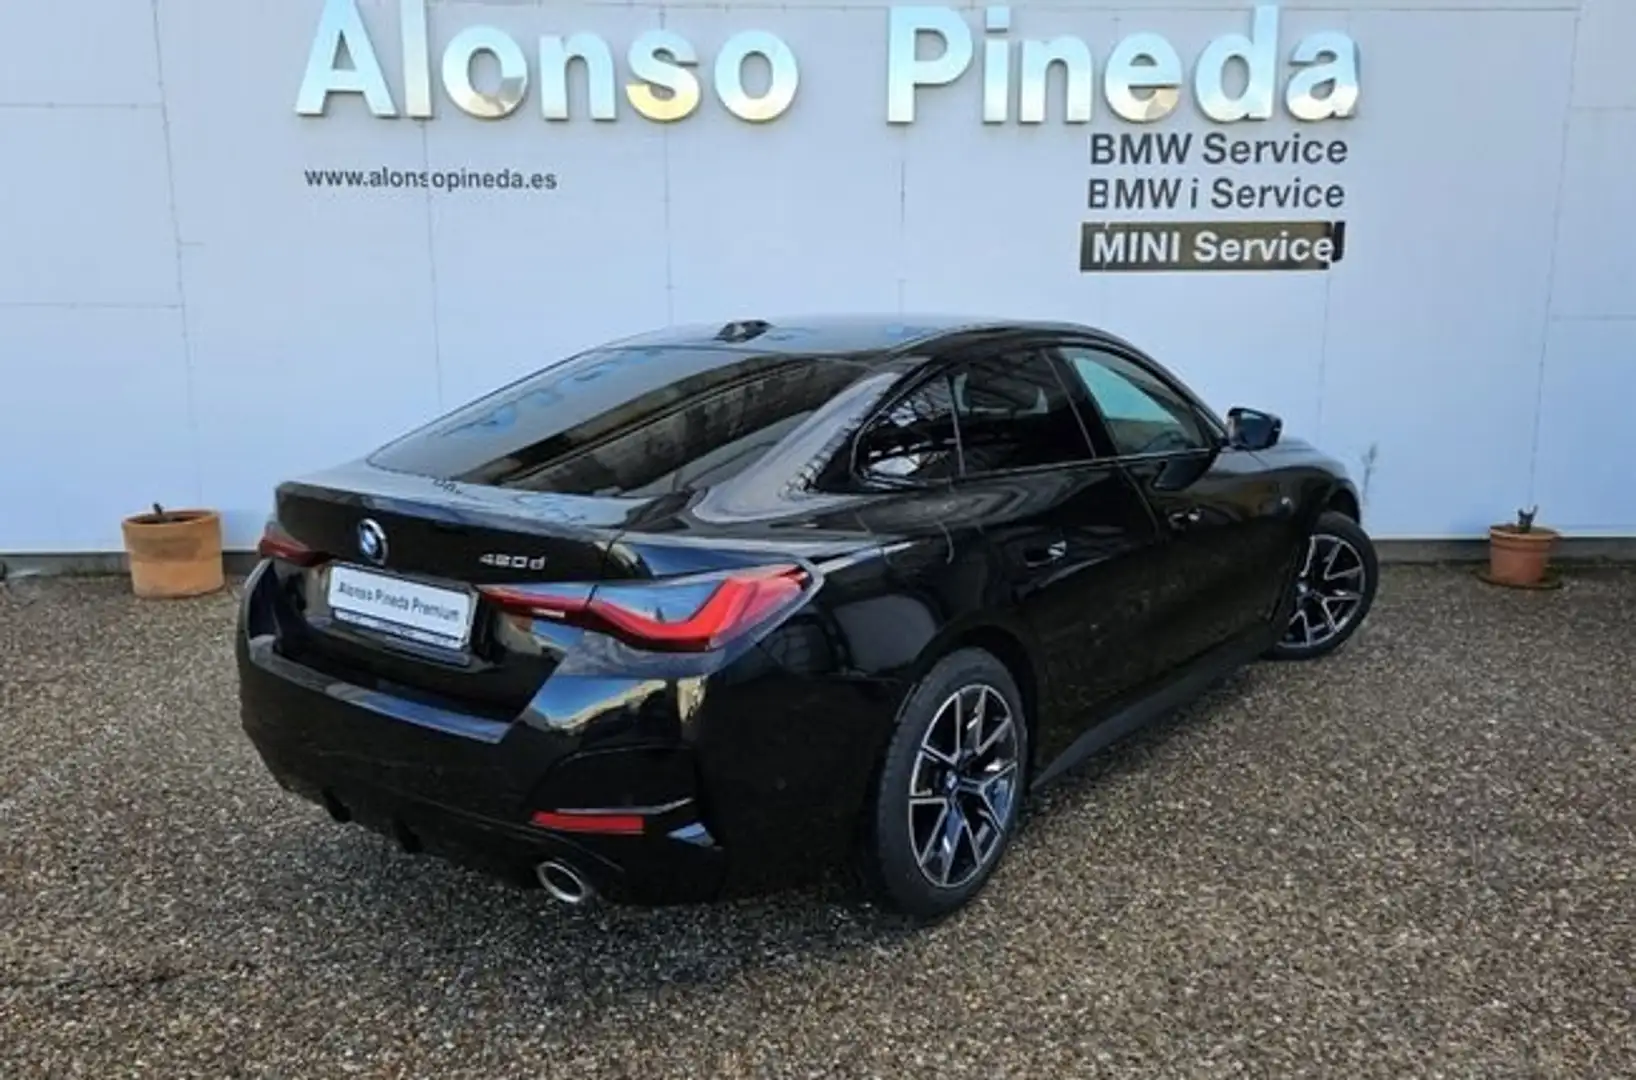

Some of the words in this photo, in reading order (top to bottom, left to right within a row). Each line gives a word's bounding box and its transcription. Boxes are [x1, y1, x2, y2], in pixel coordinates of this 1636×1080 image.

[295, 0, 799, 122] Alonso
[887, 3, 1360, 123] Pineda
[1089, 133, 1192, 165] BMW
[1202, 131, 1348, 165] Service
[304, 166, 558, 192] www.alonsopineda.es
[1087, 177, 1182, 210] BMW
[1189, 177, 1199, 209] i
[1210, 176, 1345, 209] Service
[1092, 231, 1181, 263] MINI
[1193, 230, 1335, 263] Service
[479, 553, 546, 571] 420d
[338, 581, 374, 602] Alonso
[375, 588, 410, 611] Pineda
[411, 596, 461, 622] Premium
